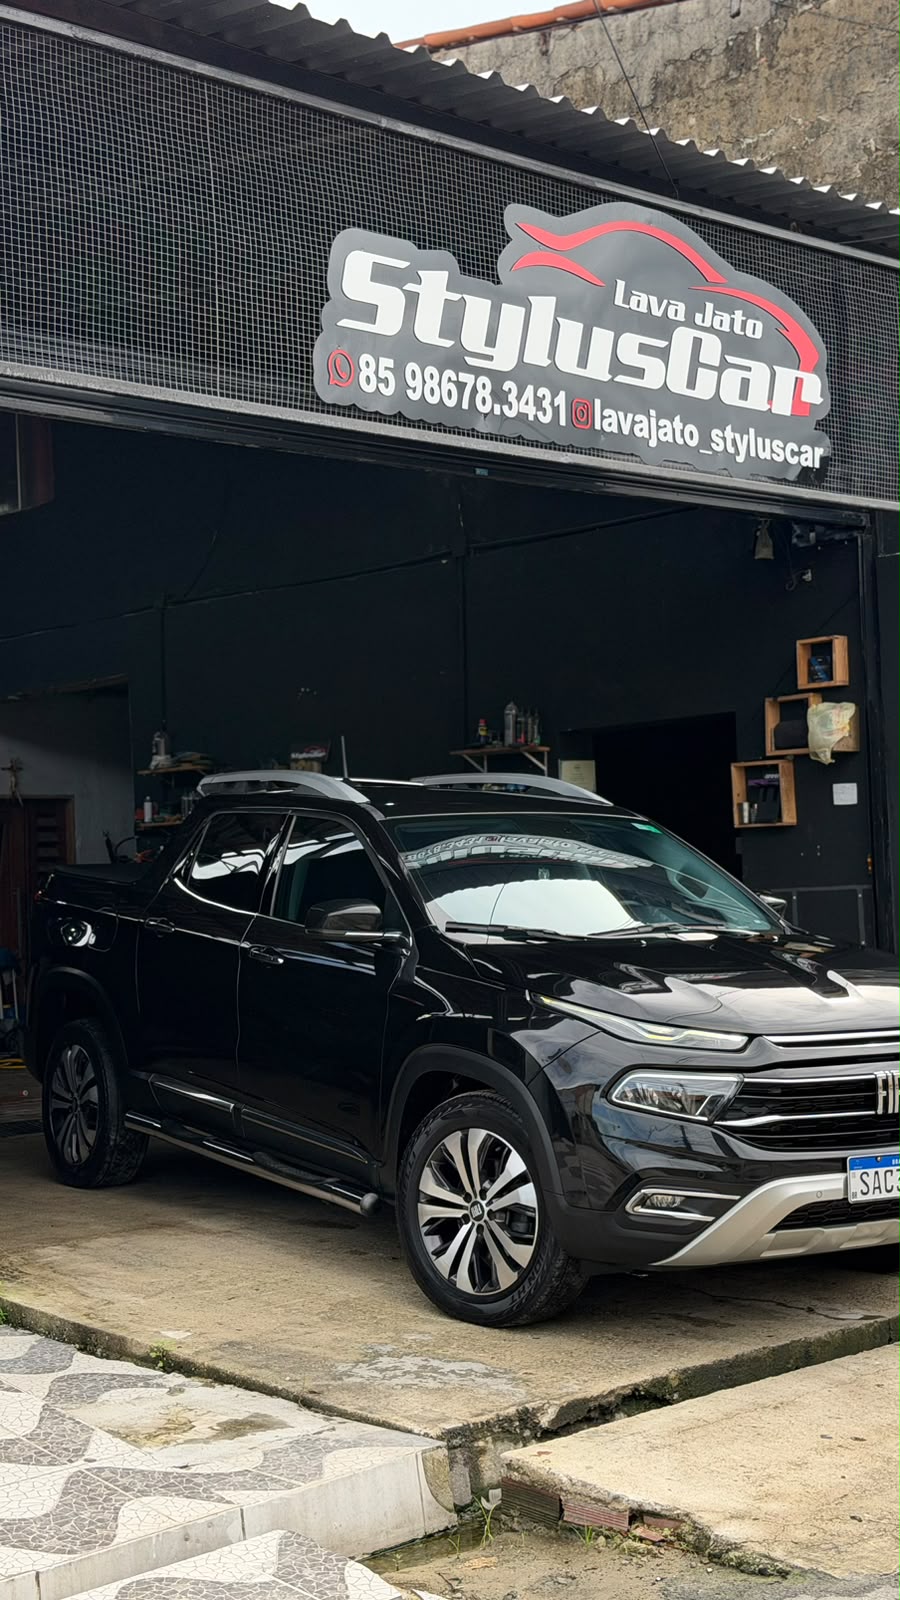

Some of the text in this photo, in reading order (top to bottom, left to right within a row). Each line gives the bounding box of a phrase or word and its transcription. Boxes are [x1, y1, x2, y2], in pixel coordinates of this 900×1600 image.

[336, 249, 824, 416] StylusCar
[614, 278, 764, 340] Lava Jato
[357, 353, 568, 426] 85 98678.3431
[594, 398, 824, 469] lavajato_styluscar
